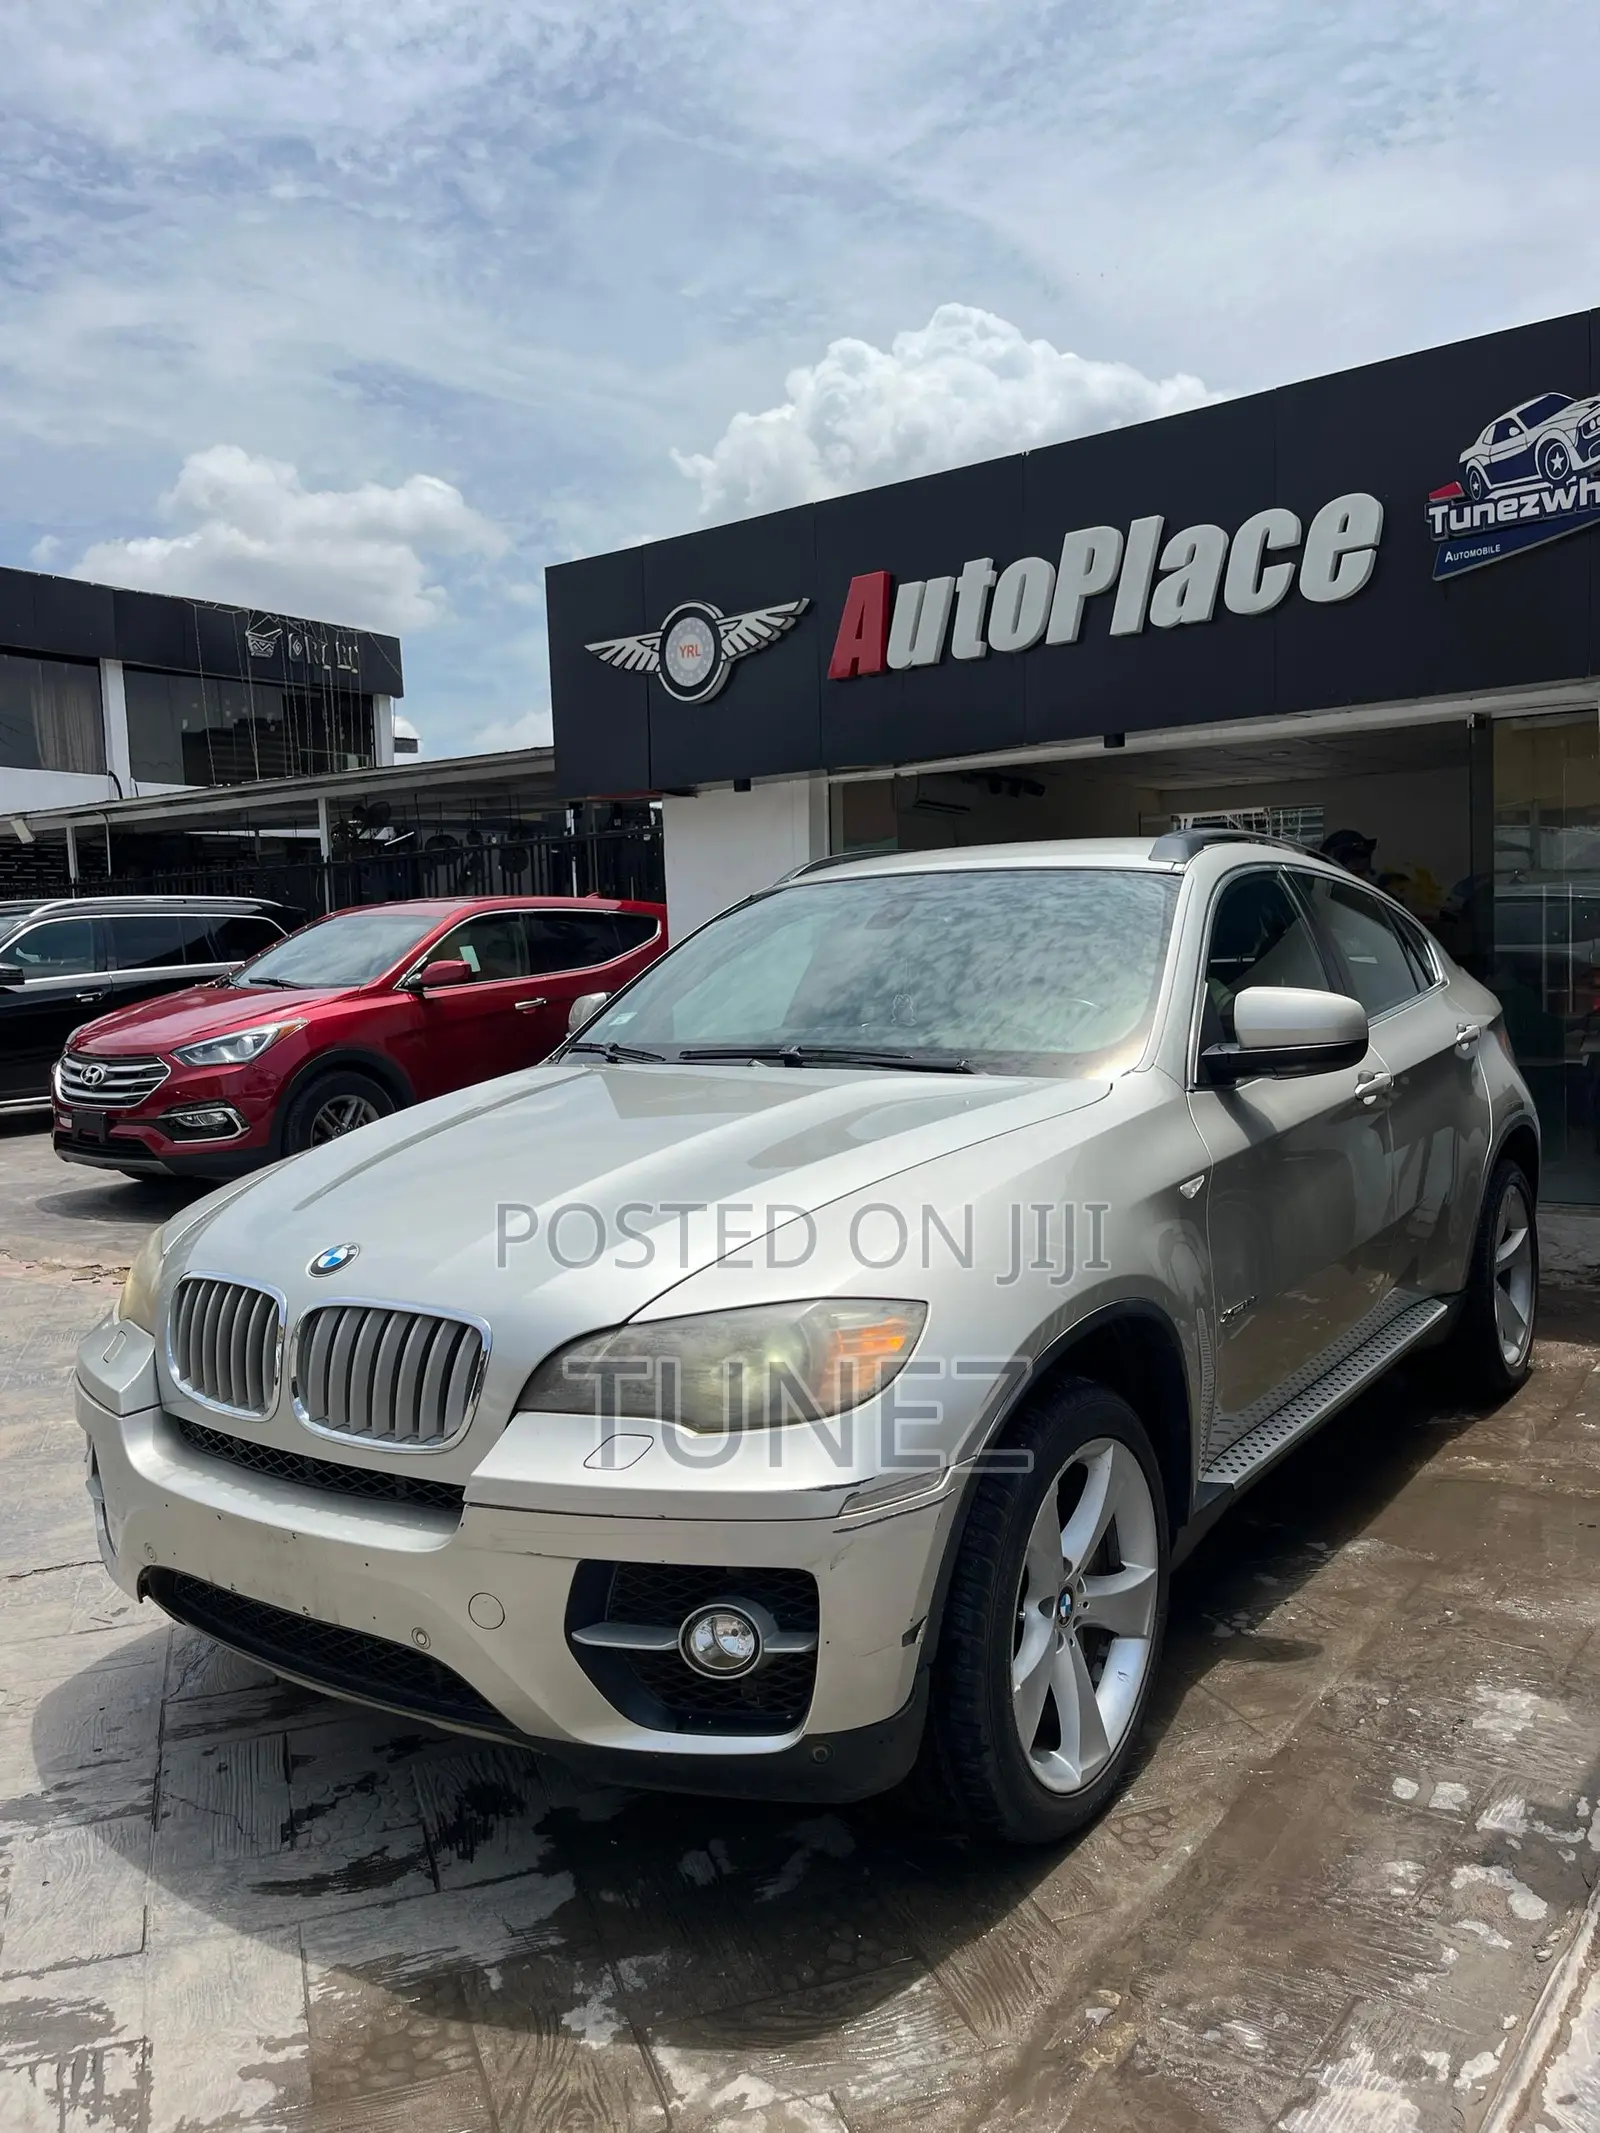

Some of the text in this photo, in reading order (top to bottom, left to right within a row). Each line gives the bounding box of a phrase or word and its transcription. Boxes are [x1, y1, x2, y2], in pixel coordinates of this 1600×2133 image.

[1445, 544, 1501, 563] AUTOMOBILE
[827, 492, 1384, 680] AutoPlace
[679, 643, 702, 659] YRL
